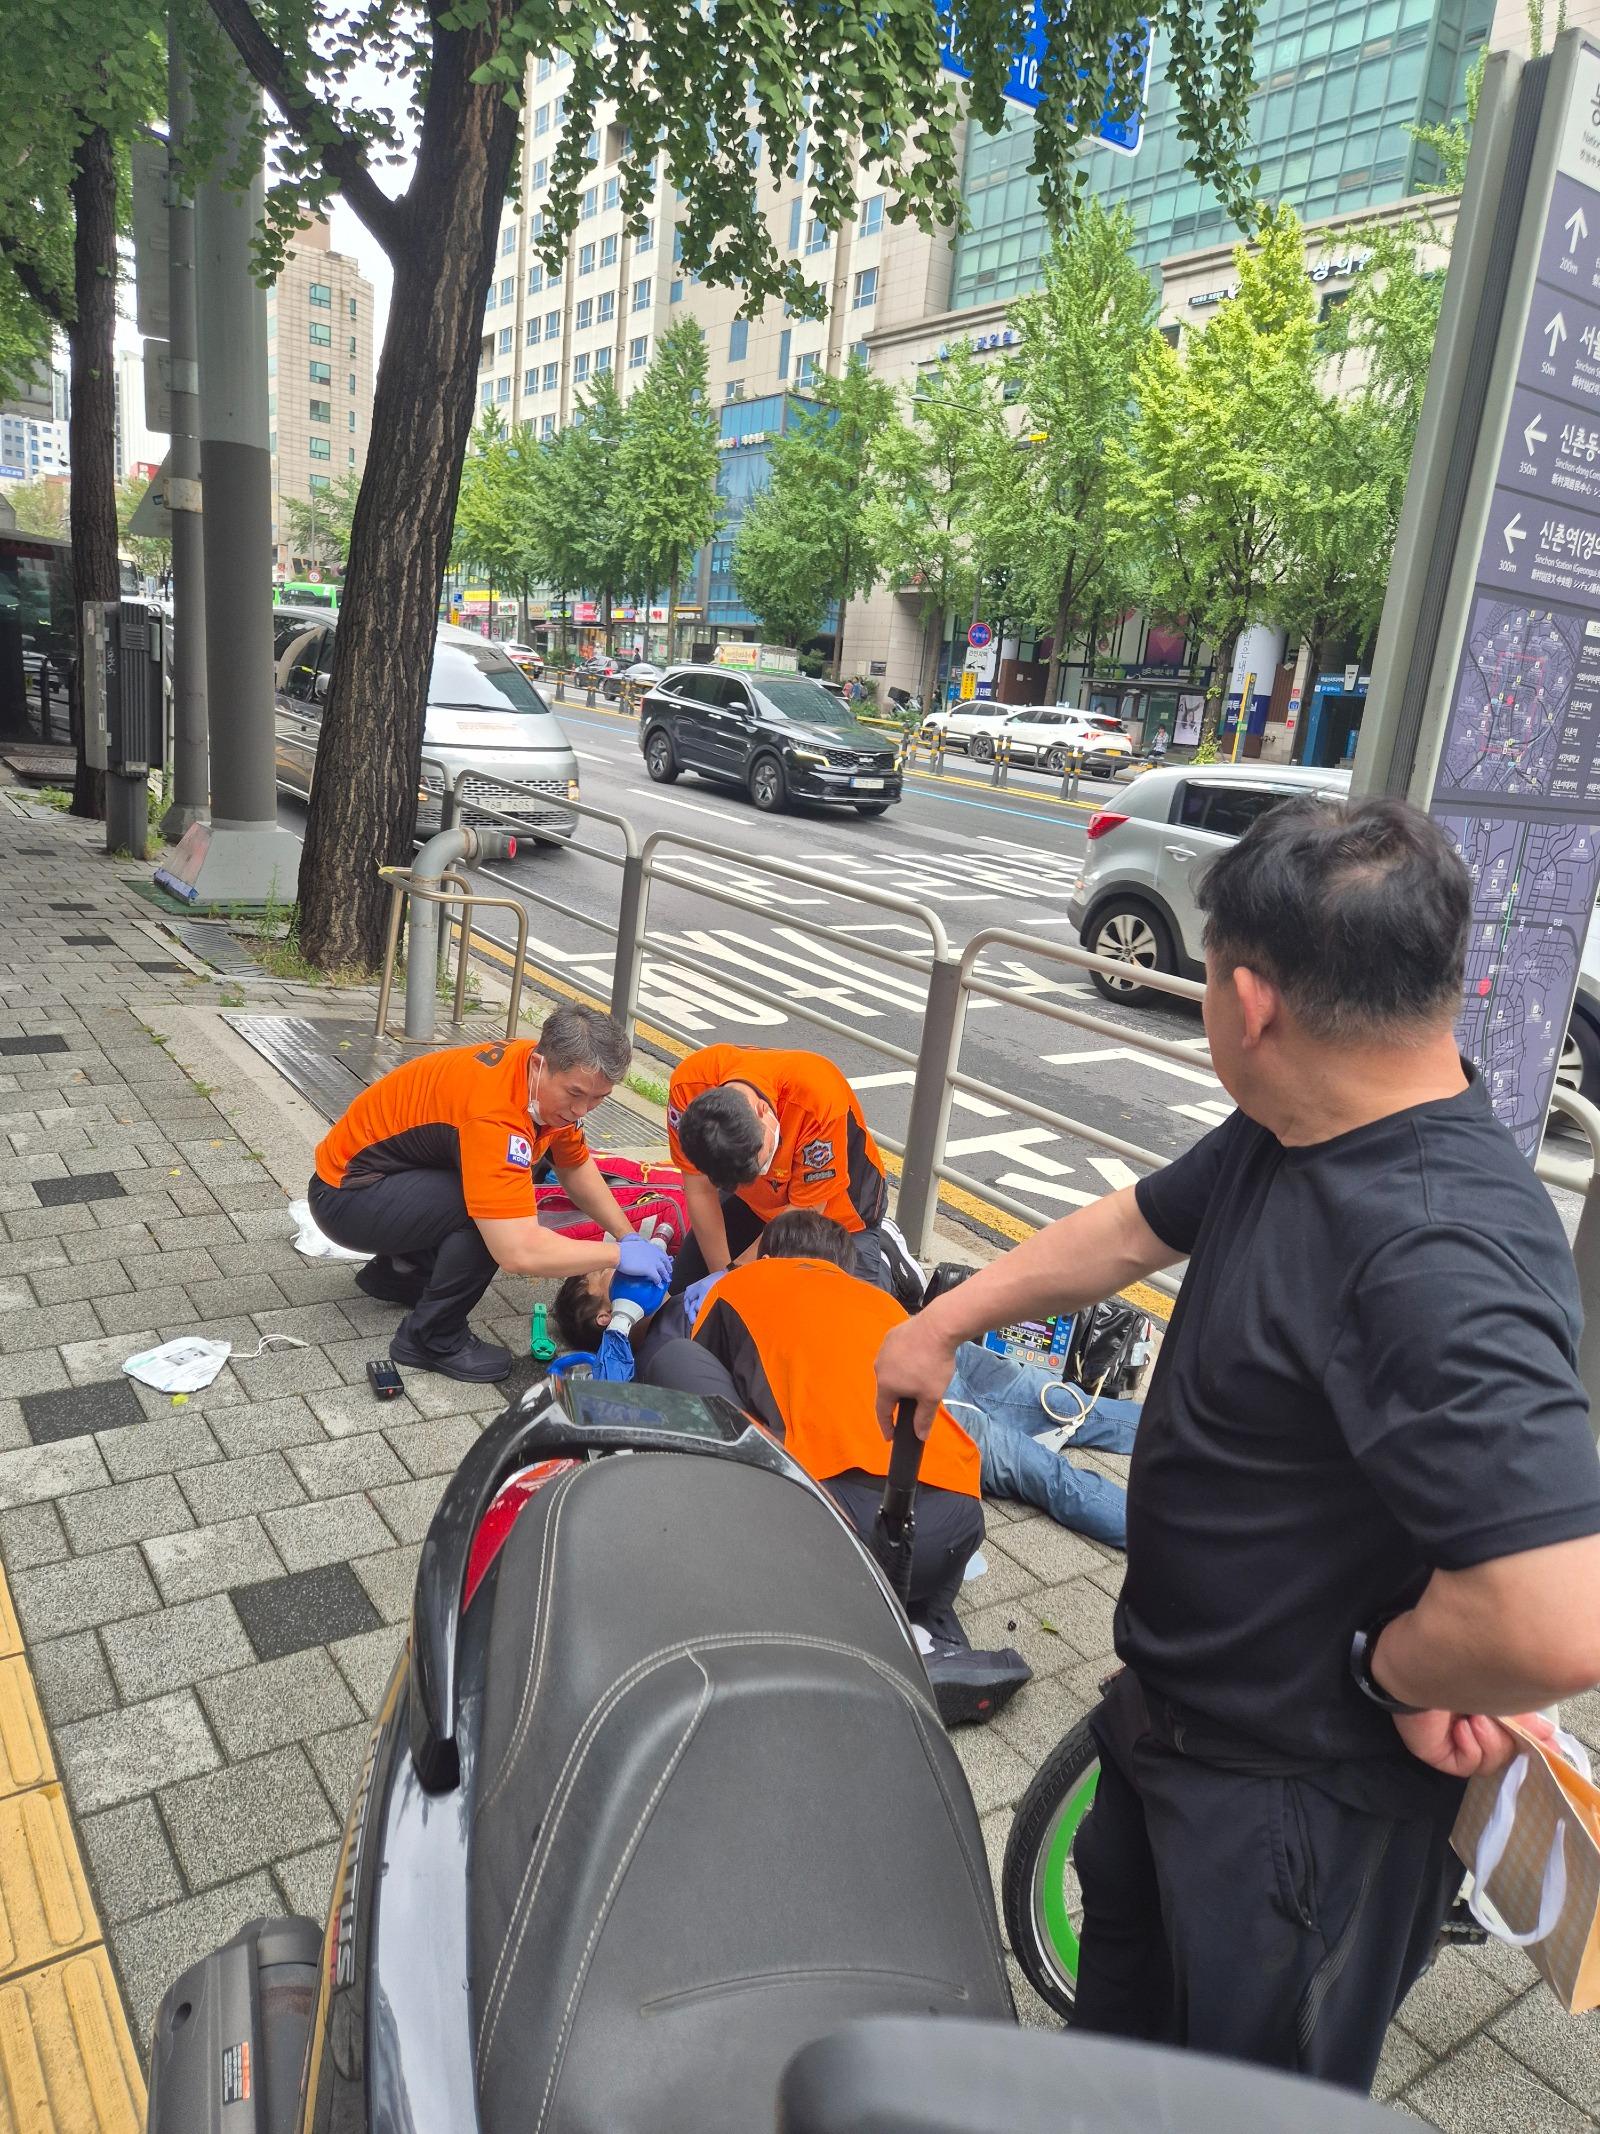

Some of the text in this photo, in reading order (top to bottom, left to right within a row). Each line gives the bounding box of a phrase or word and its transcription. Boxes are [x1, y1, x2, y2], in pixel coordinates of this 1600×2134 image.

[1559, 256, 1578, 276] 200m
[1541, 361, 1556, 377] 50m
[1560, 424, 1600, 462] 신촌동
[1519, 461, 1537, 477] 350m
[1498, 560, 1517, 573] 300m
